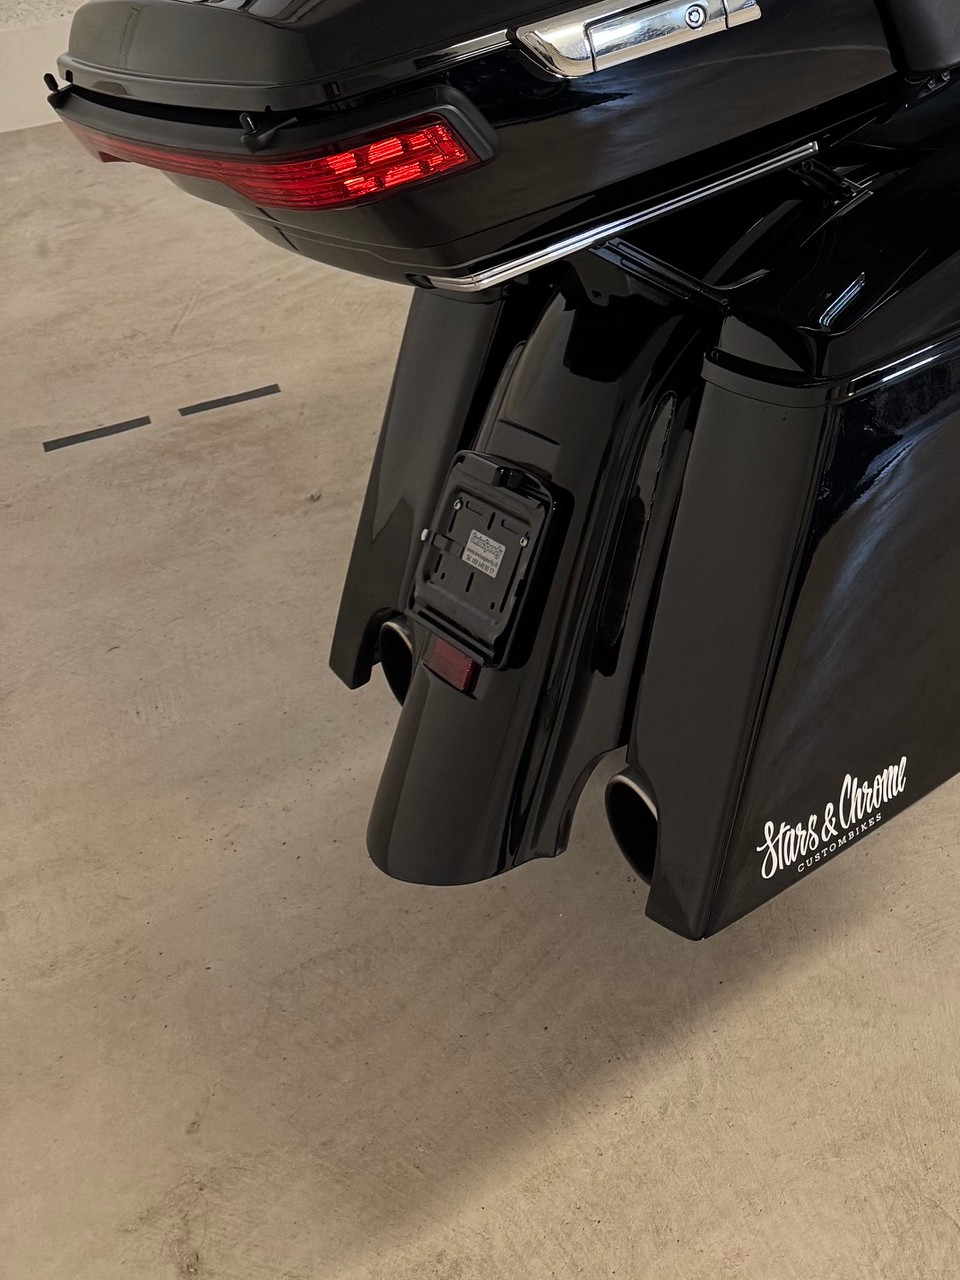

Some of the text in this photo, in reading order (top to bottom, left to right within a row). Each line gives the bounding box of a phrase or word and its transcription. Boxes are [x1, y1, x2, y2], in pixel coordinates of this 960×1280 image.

[756, 756, 907, 879] Stars & Chrome
[797, 812, 882, 873] CUSTOMBIKES
